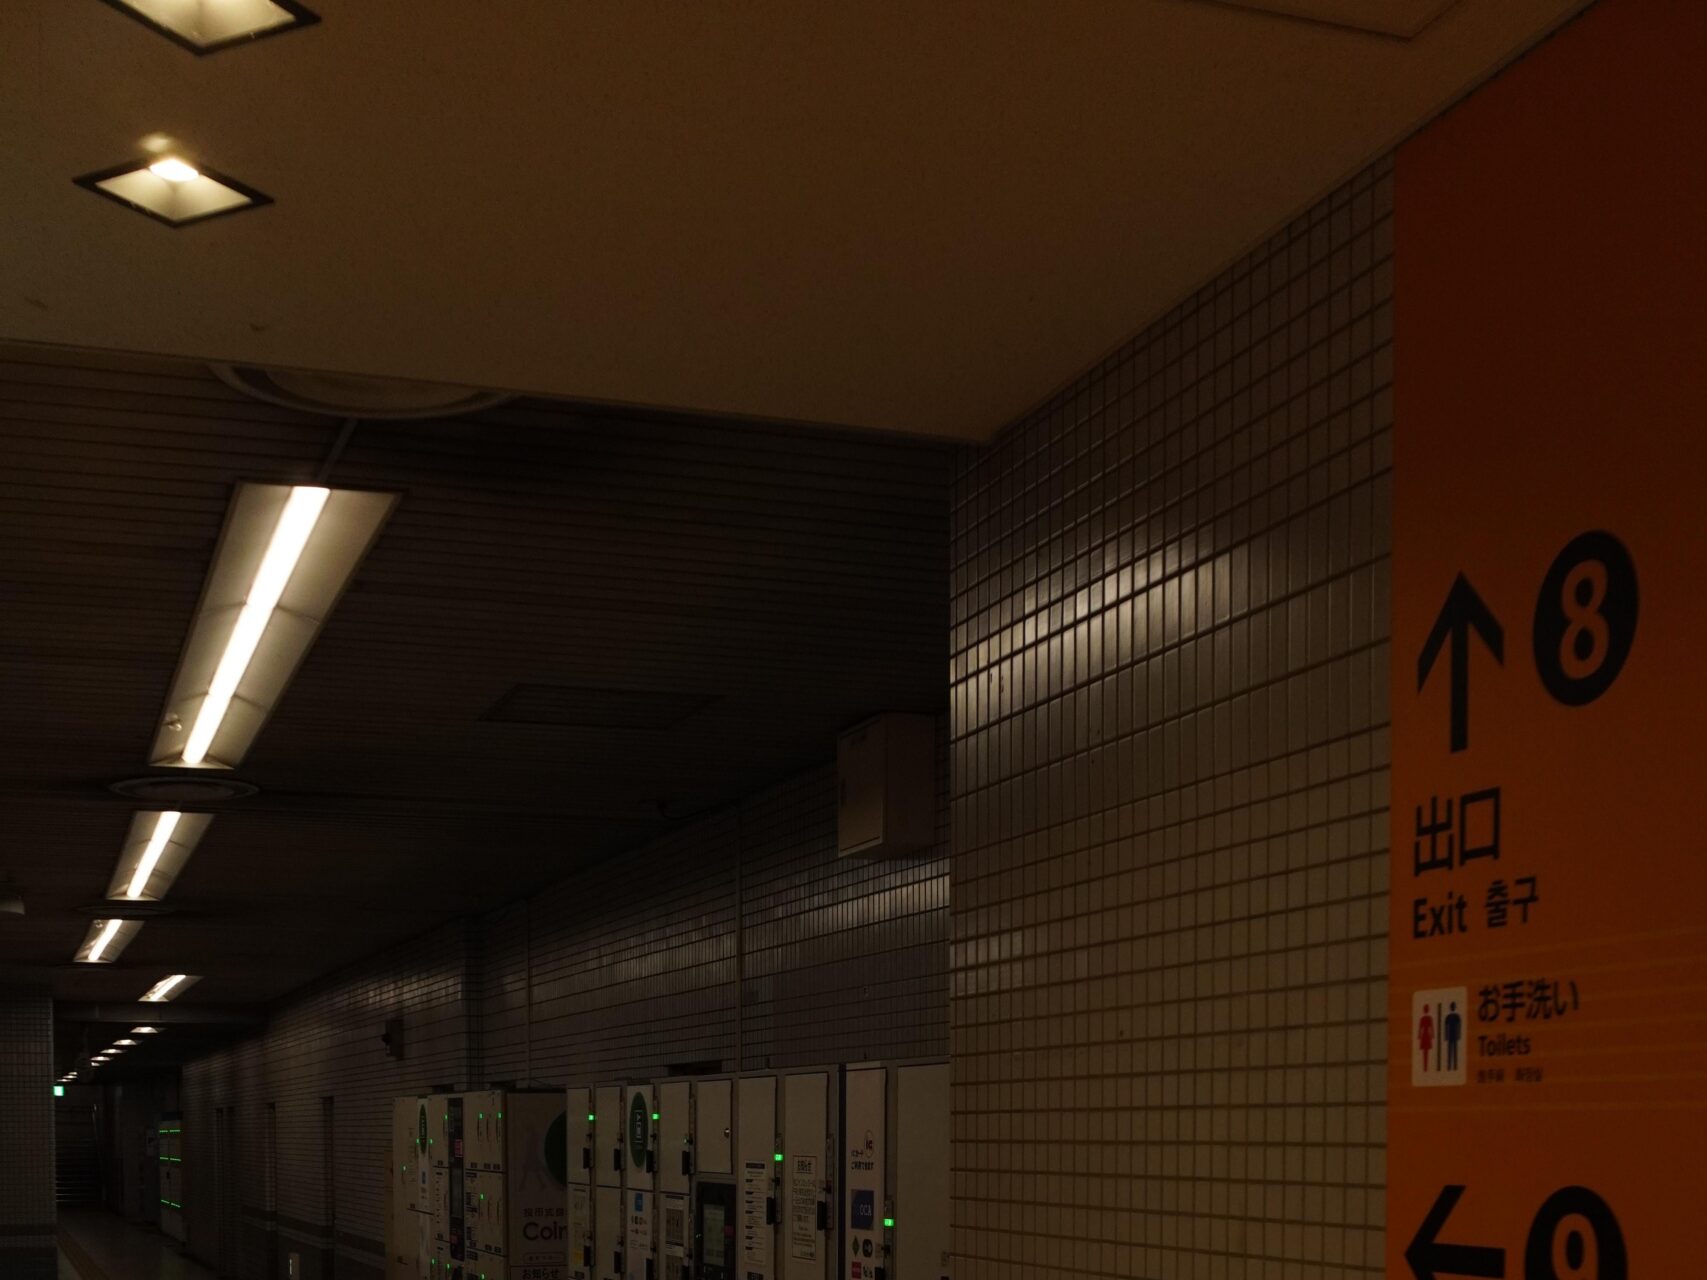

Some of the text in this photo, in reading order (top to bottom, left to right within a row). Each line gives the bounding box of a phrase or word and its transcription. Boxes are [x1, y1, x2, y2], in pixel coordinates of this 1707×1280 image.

[1558, 559, 1610, 681] 8
[1413, 787, 1500, 877] 出口
[1413, 876, 1539, 940] Exit 출구
[1477, 980, 1579, 1023] お手洗い
[1477, 1034, 1532, 1058] Toilets
